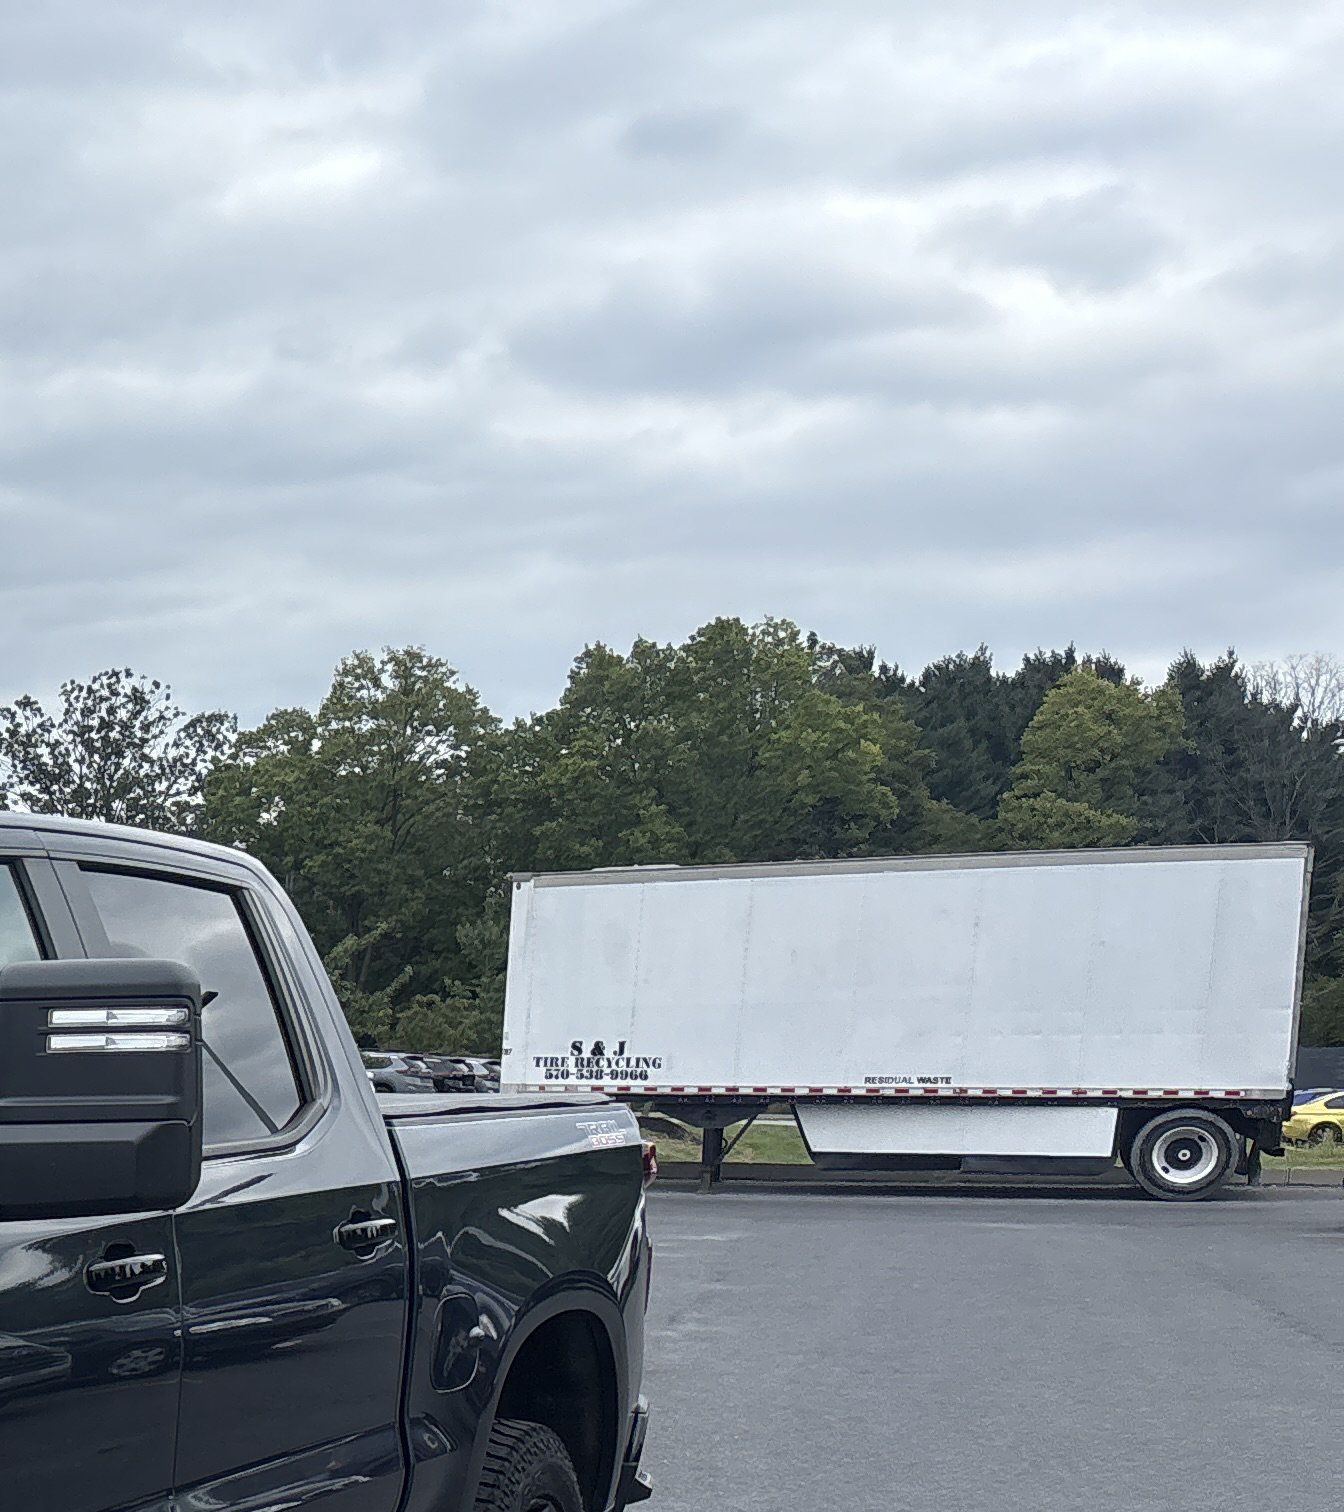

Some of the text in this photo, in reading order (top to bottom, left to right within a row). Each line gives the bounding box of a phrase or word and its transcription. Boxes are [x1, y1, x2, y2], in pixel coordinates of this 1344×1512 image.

[570, 1040, 627, 1056] S & J
[533, 1056, 662, 1069] TIRE RECYCLING
[864, 1076, 952, 1085] RESIDUAL WASTE
[576, 1120, 627, 1135] TRAIL
[589, 1133, 627, 1149] BOSS
